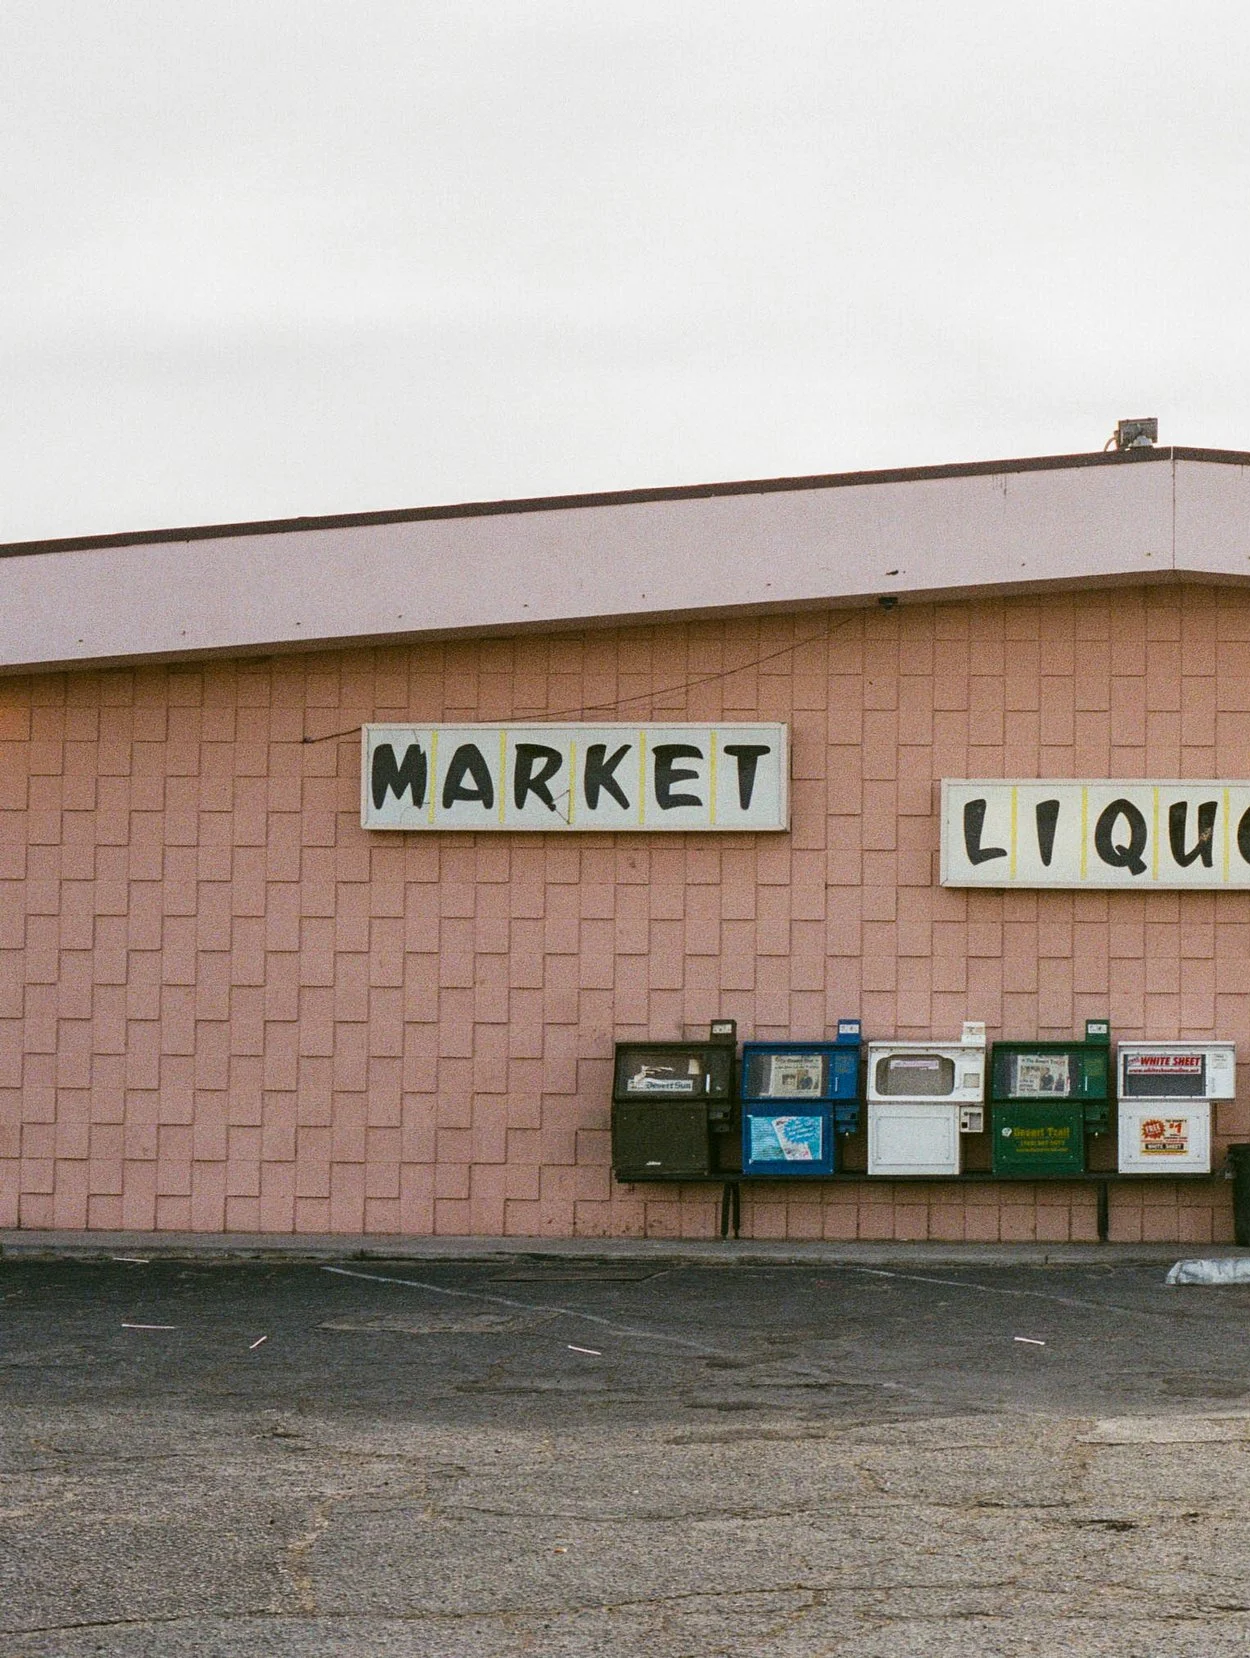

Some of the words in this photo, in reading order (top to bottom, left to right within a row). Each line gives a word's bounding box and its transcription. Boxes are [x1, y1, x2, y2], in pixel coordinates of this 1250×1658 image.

[371, 743, 771, 811] MARKET
[1140, 1056, 1170, 1066] WHITE
[1173, 1056, 1201, 1066] SHEET
[675, 1081, 691, 1089] Sun
